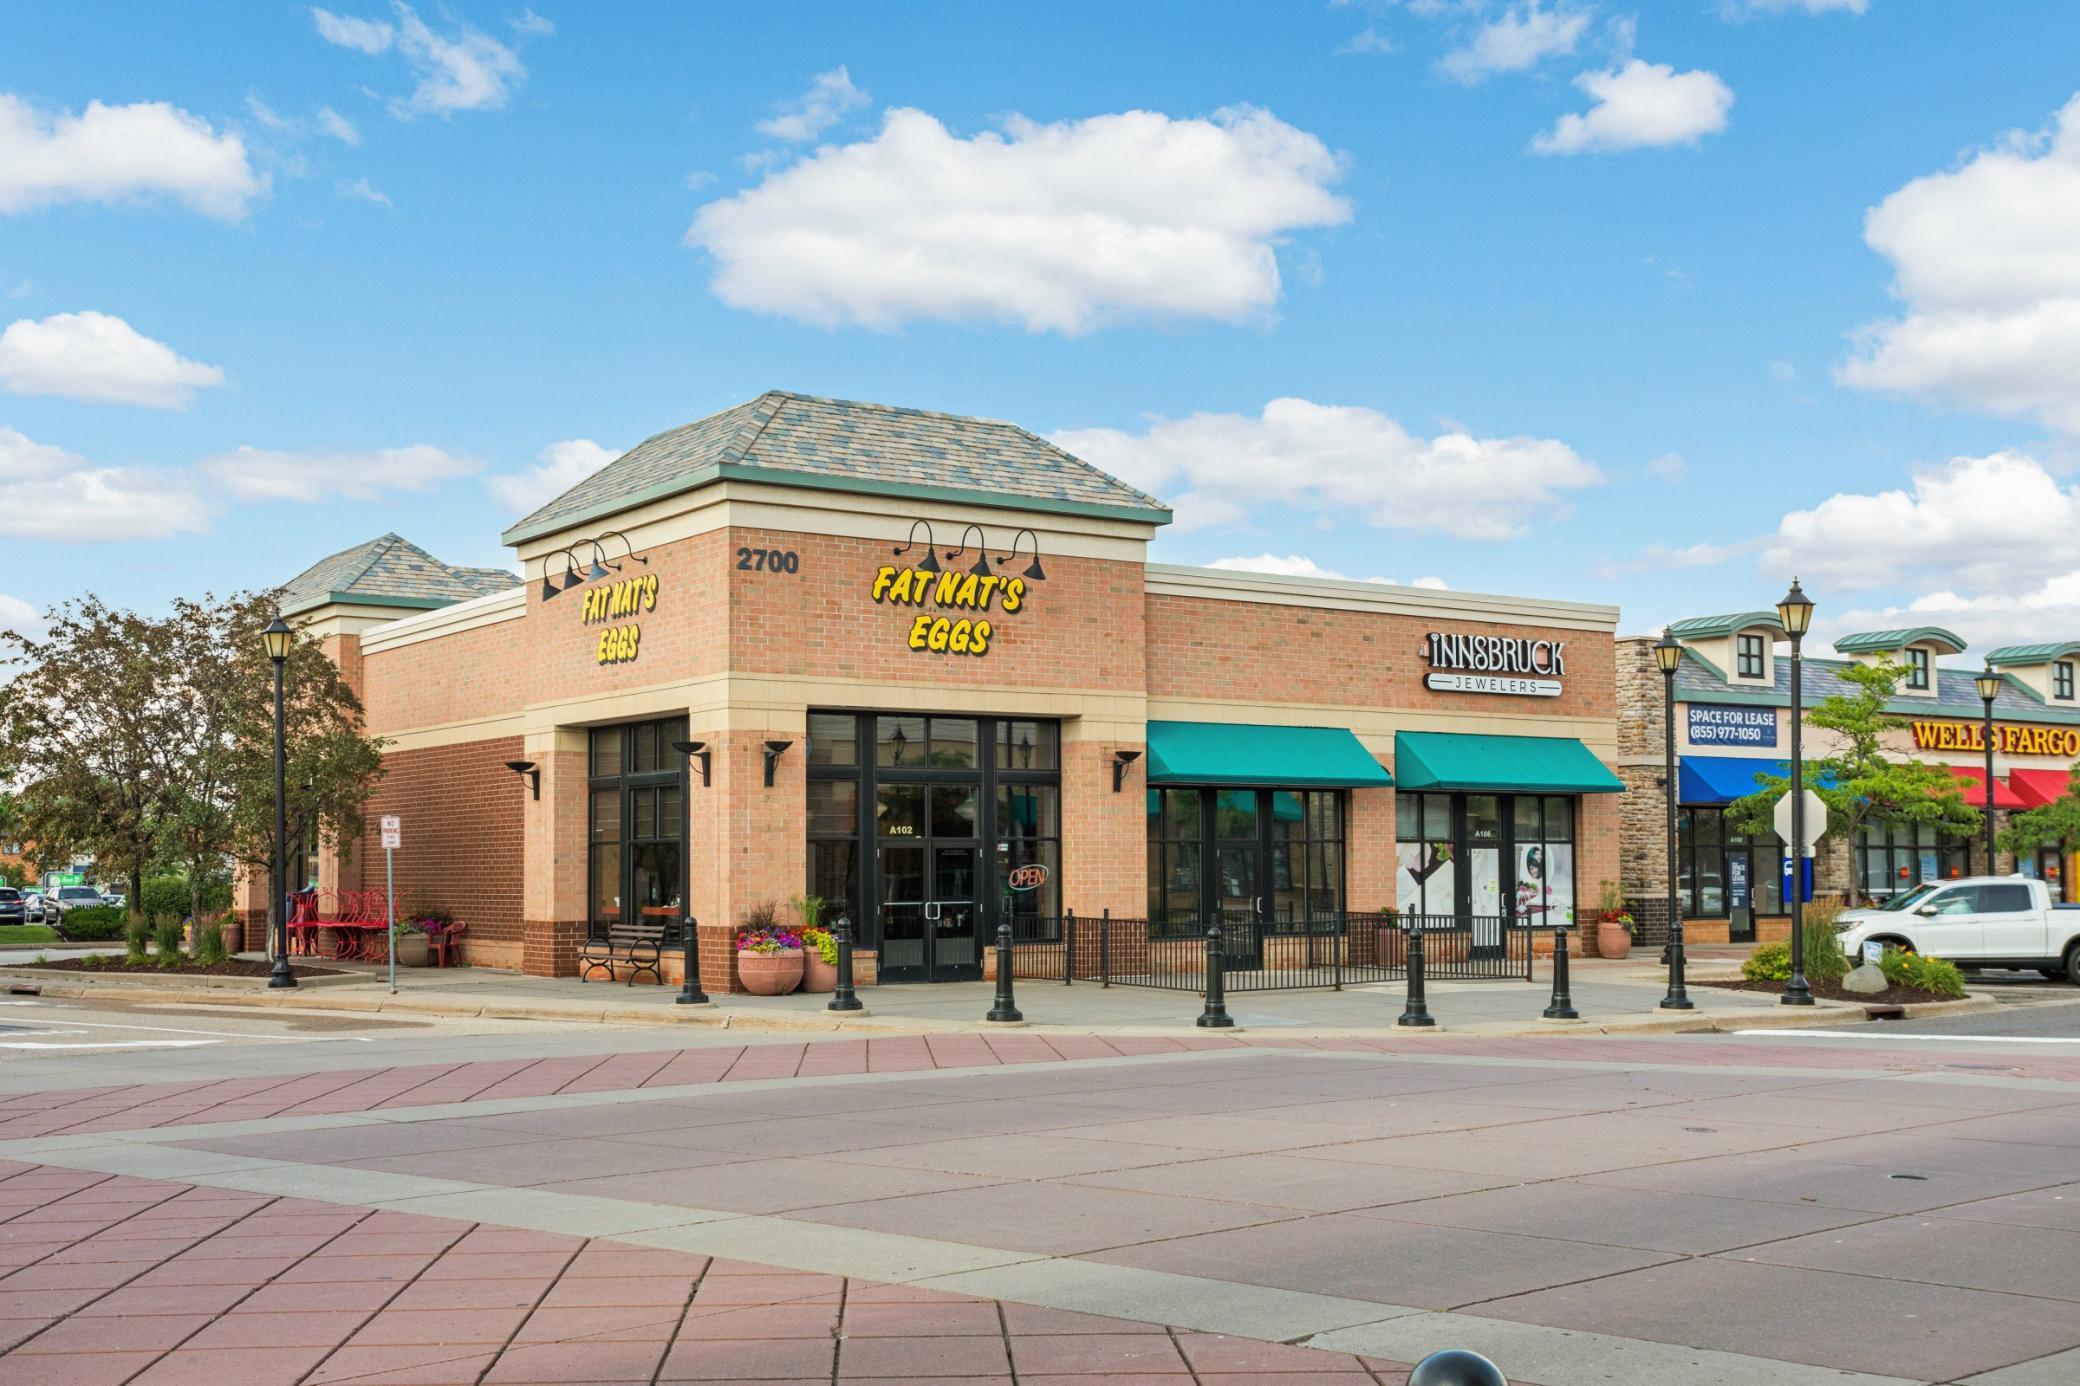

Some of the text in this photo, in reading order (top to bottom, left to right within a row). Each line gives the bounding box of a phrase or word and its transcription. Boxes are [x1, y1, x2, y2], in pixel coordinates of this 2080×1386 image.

[737, 547, 799, 573] 2700
[581, 573, 659, 626] FAT NAT'S
[872, 566, 1027, 614] FAT NAT'S
[597, 624, 641, 666] EGGS
[907, 615, 993, 657] EGGS
[1455, 676, 1537, 693] JEWELERS
[1689, 709, 1775, 726] SPACE FOR LEASE
[1690, 725, 1761, 741] (855) 977-1050
[2004, 726, 2080, 757] FARGO
[889, 825, 913, 835] A102
[1475, 830, 1492, 838] A106
[1009, 867, 1046, 888] OPEN
